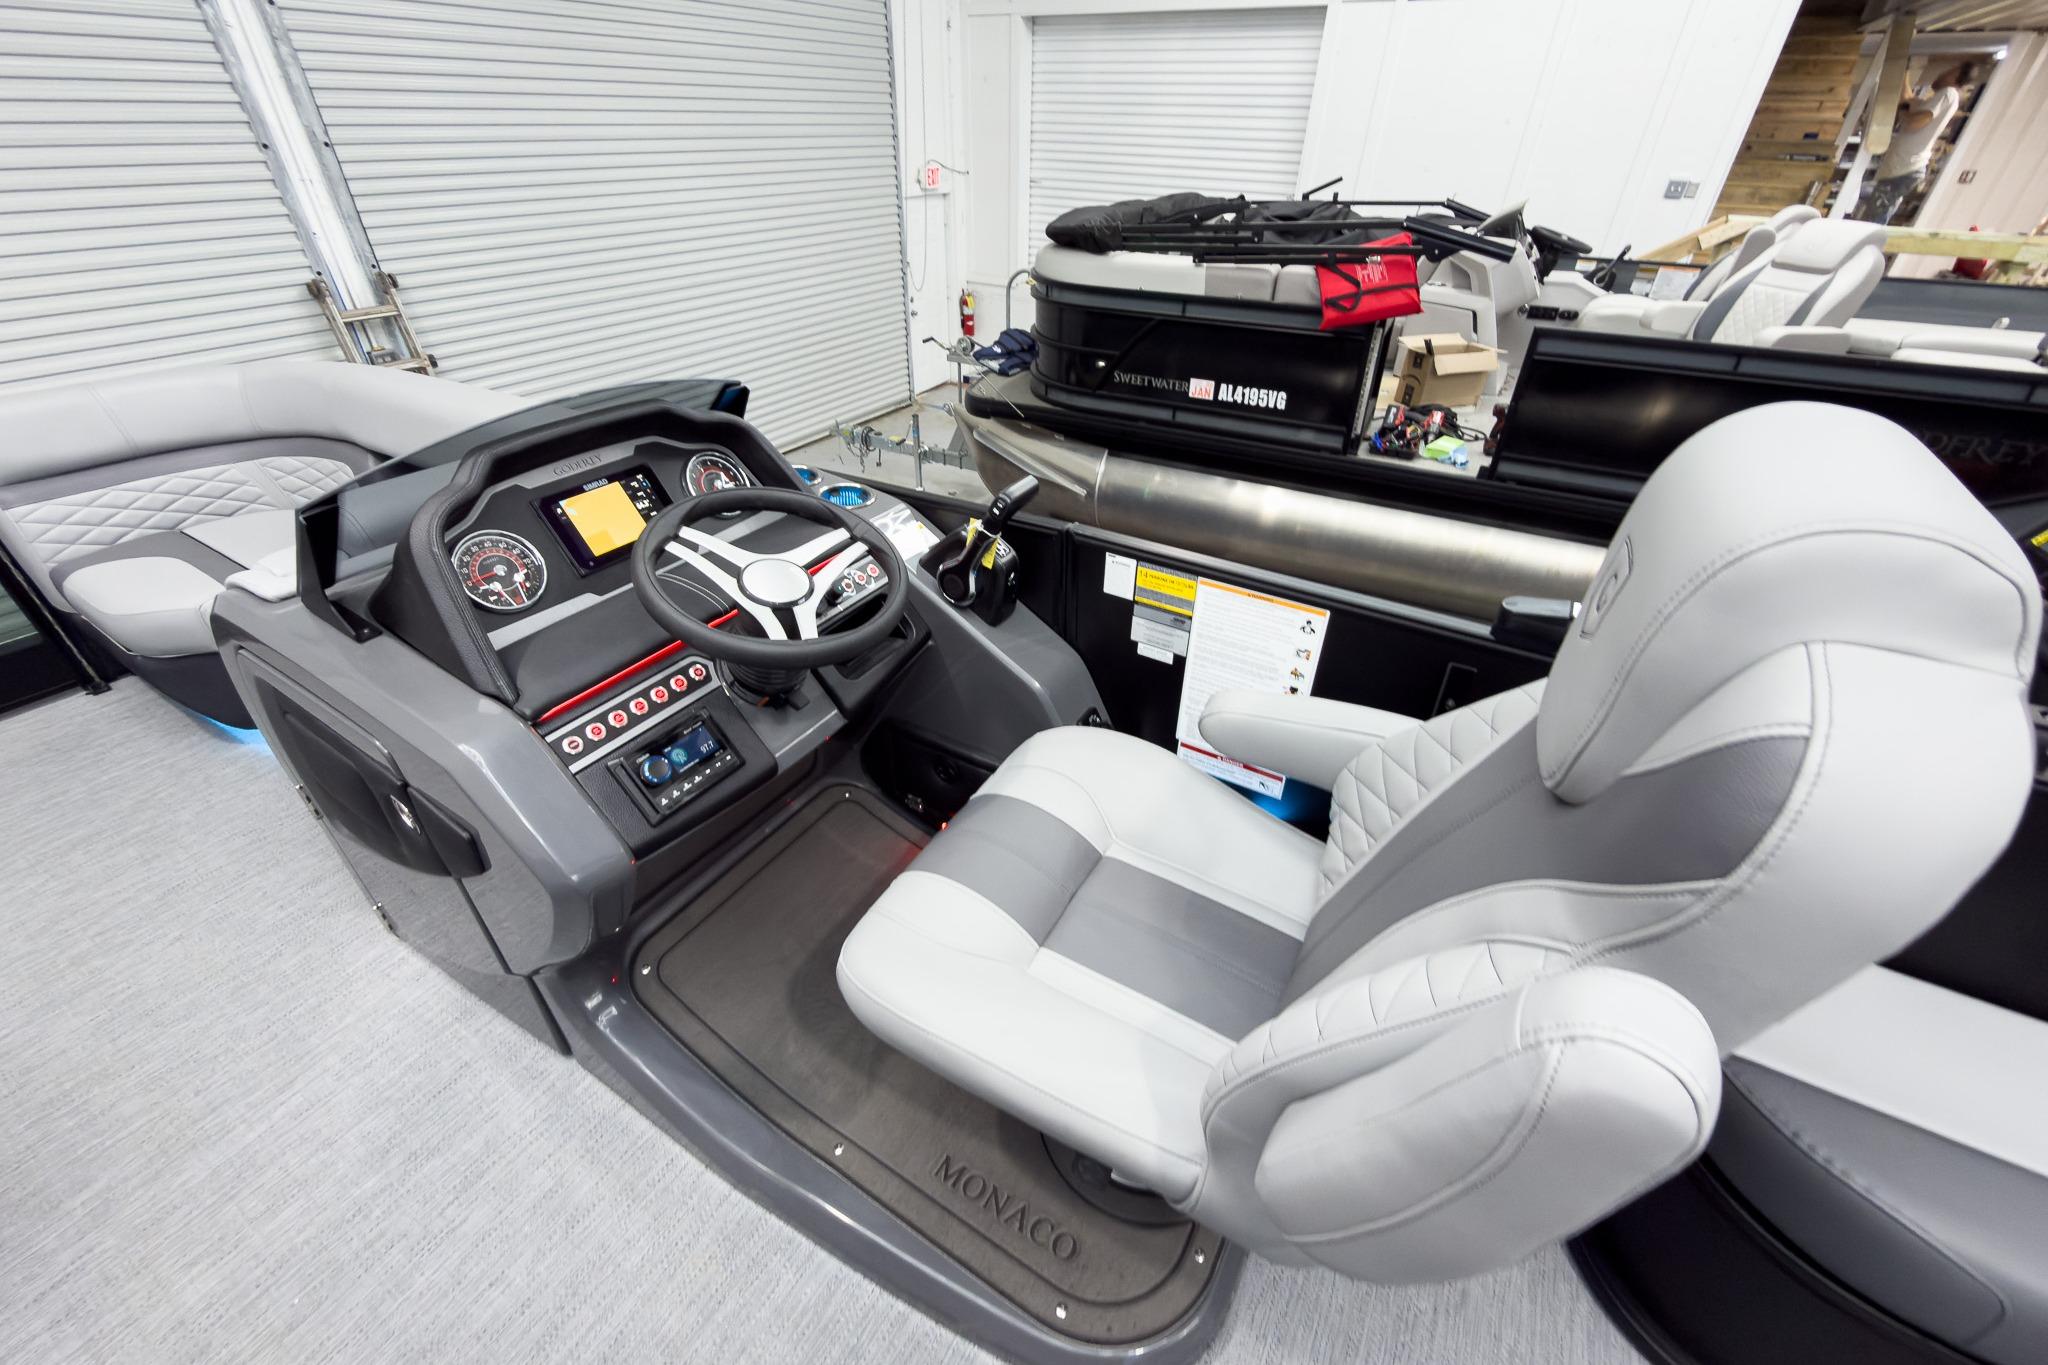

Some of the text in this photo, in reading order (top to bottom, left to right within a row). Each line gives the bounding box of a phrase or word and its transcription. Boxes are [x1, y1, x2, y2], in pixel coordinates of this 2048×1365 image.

[1113, 370, 1189, 393] SWEETWATER
[1191, 385, 1212, 398] JAN
[1217, 383, 1288, 411] AL4195VG
[553, 454, 604, 476] GODFREY
[700, 740, 714, 754] 97.7
[933, 1153, 1078, 1261] MONACO
